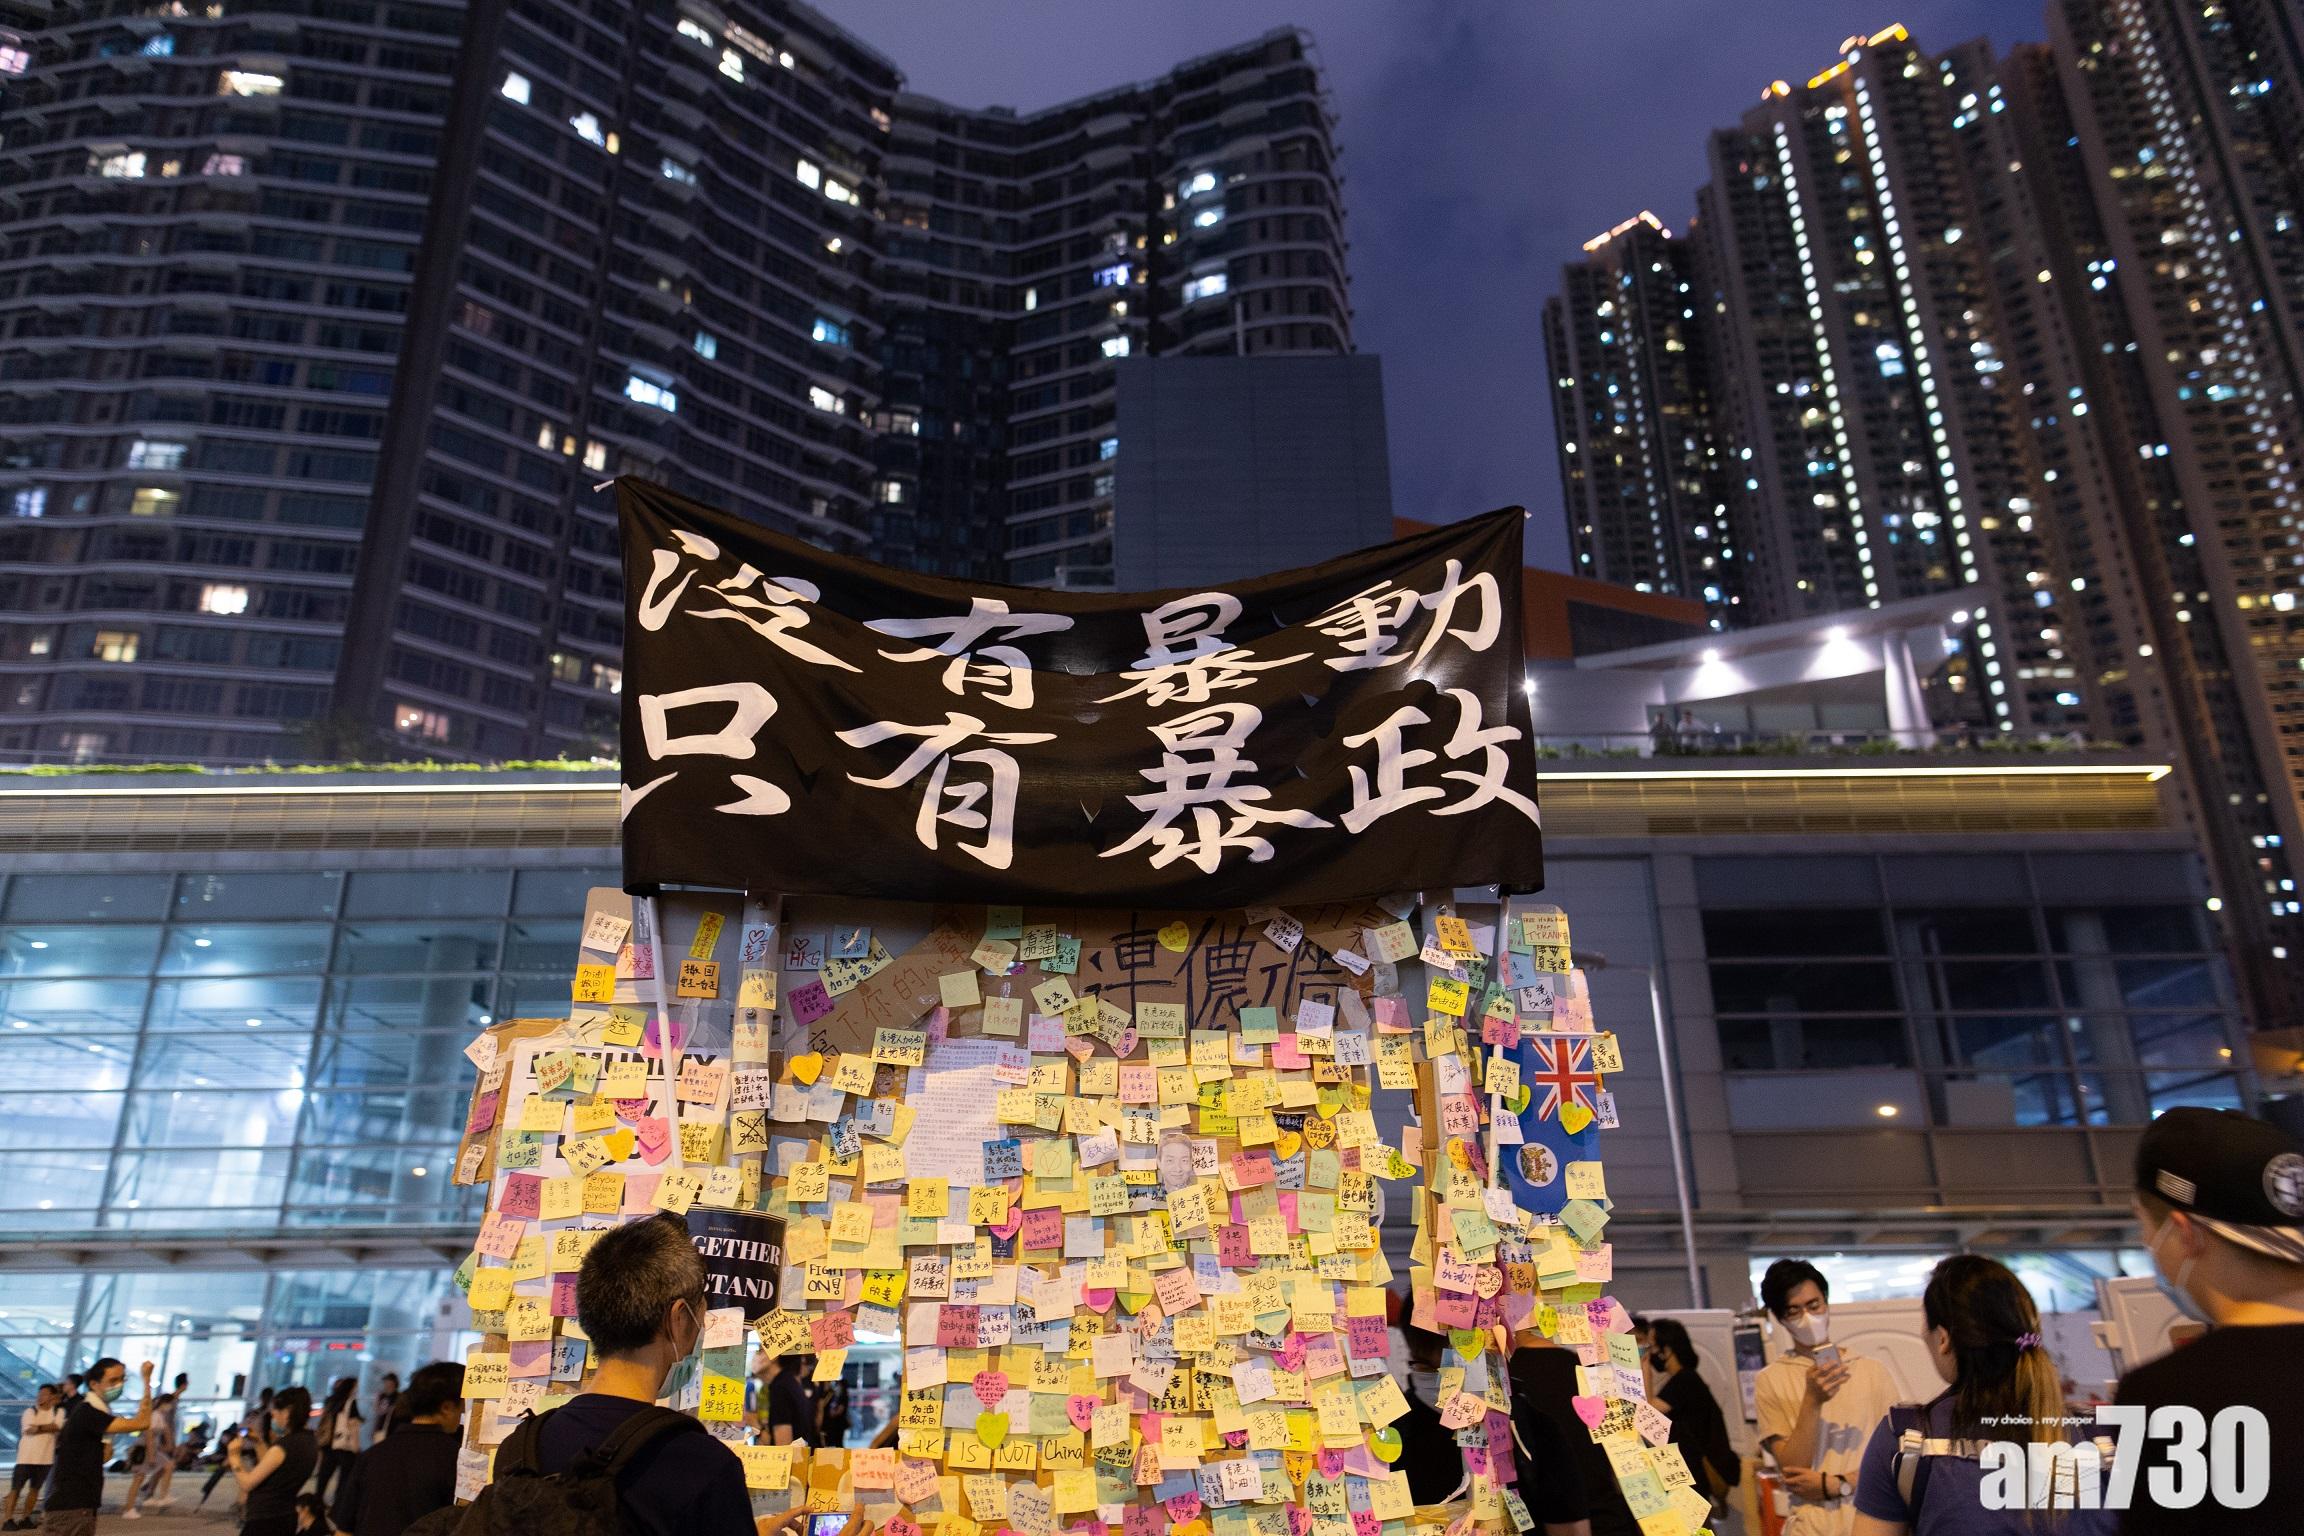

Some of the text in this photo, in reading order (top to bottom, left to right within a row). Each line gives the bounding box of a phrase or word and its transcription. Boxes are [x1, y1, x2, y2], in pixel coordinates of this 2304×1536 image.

[620, 682, 1541, 874] 只有暴政
[1026, 928, 1055, 944] 香港
[1024, 945, 1056, 957] 加油
[790, 950, 822, 967] HKG
[880, 1031, 924, 1045] 香港人加油!
[841, 1066, 866, 1081] 香港人
[1126, 1173, 1152, 1181] ALL!!
[1452, 1174, 1470, 1187] 香港
[796, 1184, 827, 1197] 加油
[1453, 1187, 1482, 1200] 加油!
[691, 1235, 780, 1266] GETHER
[809, 1264, 844, 1276] FIGHT
[1441, 1270, 1475, 1286] 加油!!
[954, 1289, 978, 1300] 加油
[1033, 1358, 1064, 1374] 香港人
[1035, 1375, 1069, 1386] 加油!!
[707, 1383, 741, 1396] 香港人
[907, 1391, 937, 1401] 香港人
[911, 1403, 939, 1415] 加油!
[1252, 1411, 1284, 1431] 香港
[907, 1439, 1084, 1465] HK IS NOT China
[1098, 1446, 1132, 1459] 加油!
[1225, 1463, 1255, 1475] 香港人
[1306, 1480, 1332, 1498] 香港人
[810, 1491, 841, 1513] 各位
[1309, 1501, 1331, 1515] 加油
[1173, 1507, 1195, 1520] 加油
